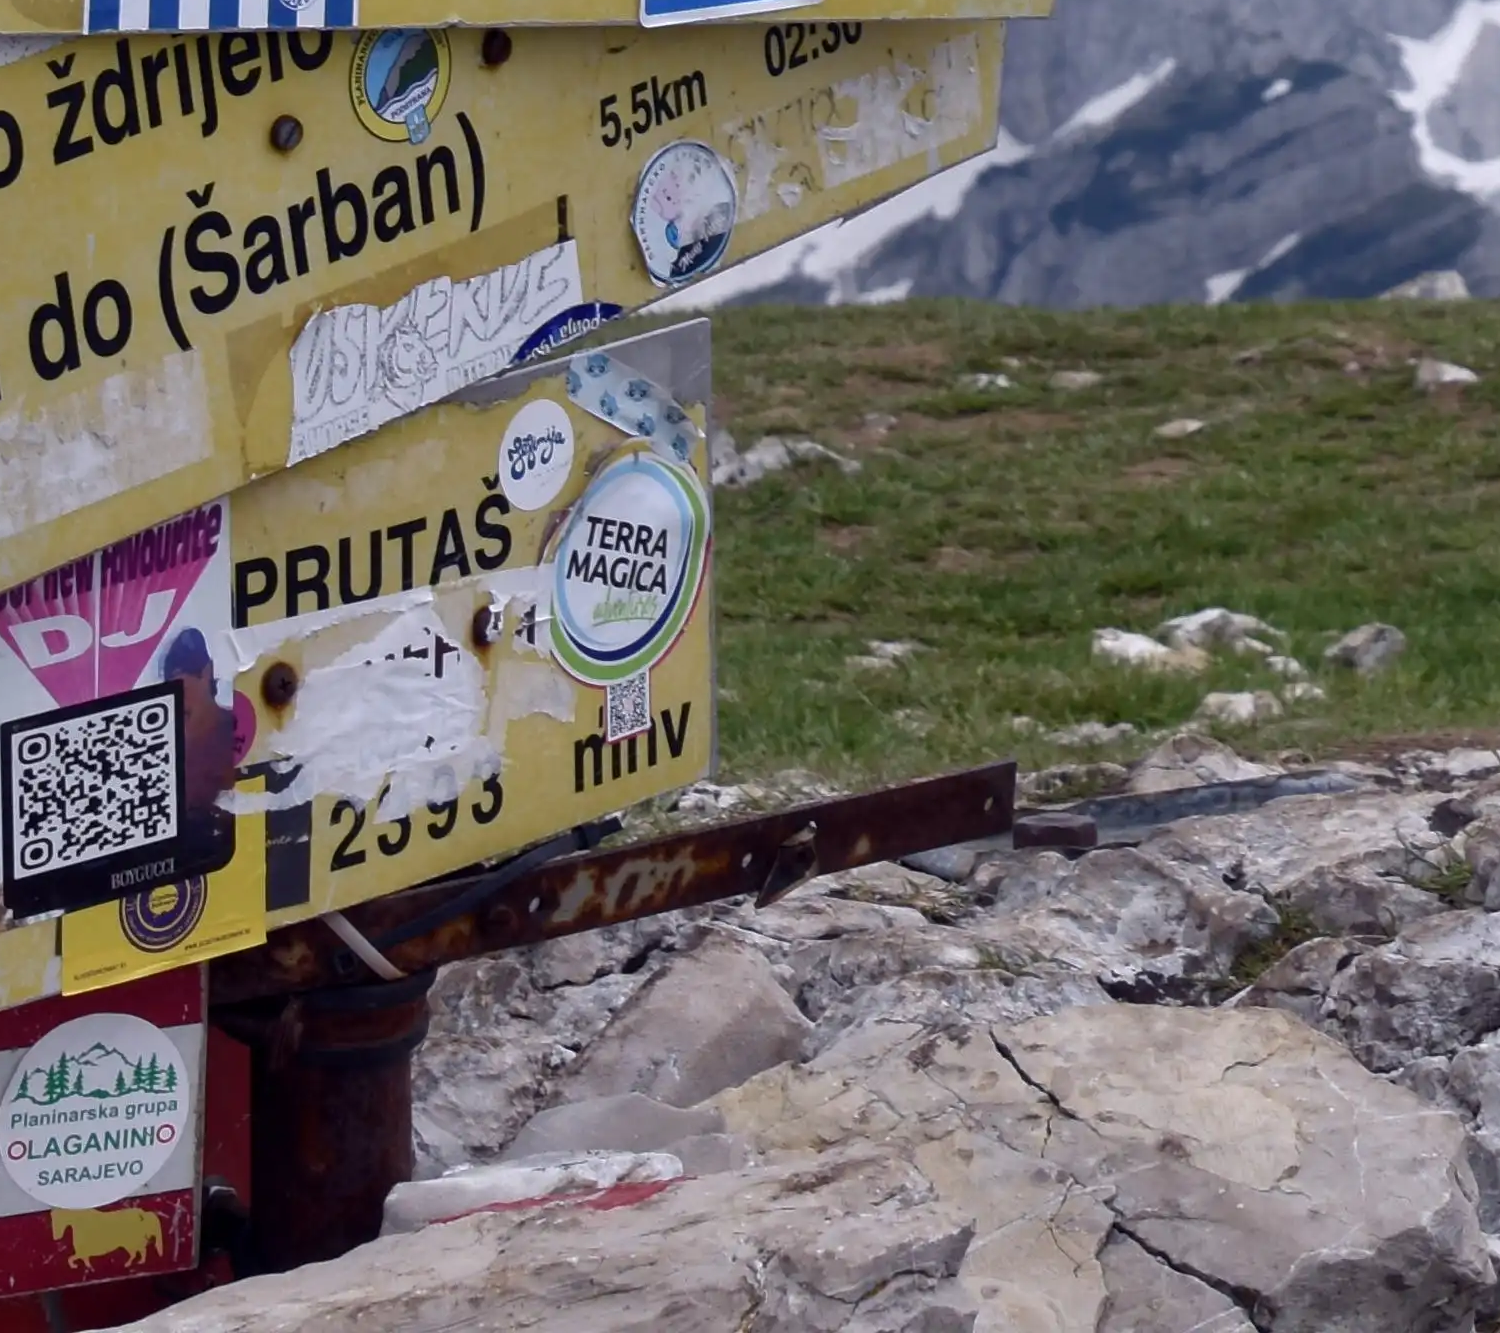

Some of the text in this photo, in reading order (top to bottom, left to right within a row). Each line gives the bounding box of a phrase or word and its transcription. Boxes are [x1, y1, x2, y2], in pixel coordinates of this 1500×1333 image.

[44, 30, 335, 166] ždrijelo
[27, 271, 133, 381] do
[157, 111, 487, 352] (Šarban)
[599, 69, 708, 151] 5,5km
[233, 473, 512, 630] PRUTAŠ
[586, 515, 668, 559] TERRA
[565, 549, 667, 595] MAGICA
[7, 588, 177, 670] DJ
[110, 857, 176, 890] BOYGUCCI
[10, 1099, 179, 1130] Planinarska grupa
[37, 1159, 144, 1186] SARAJEVO
